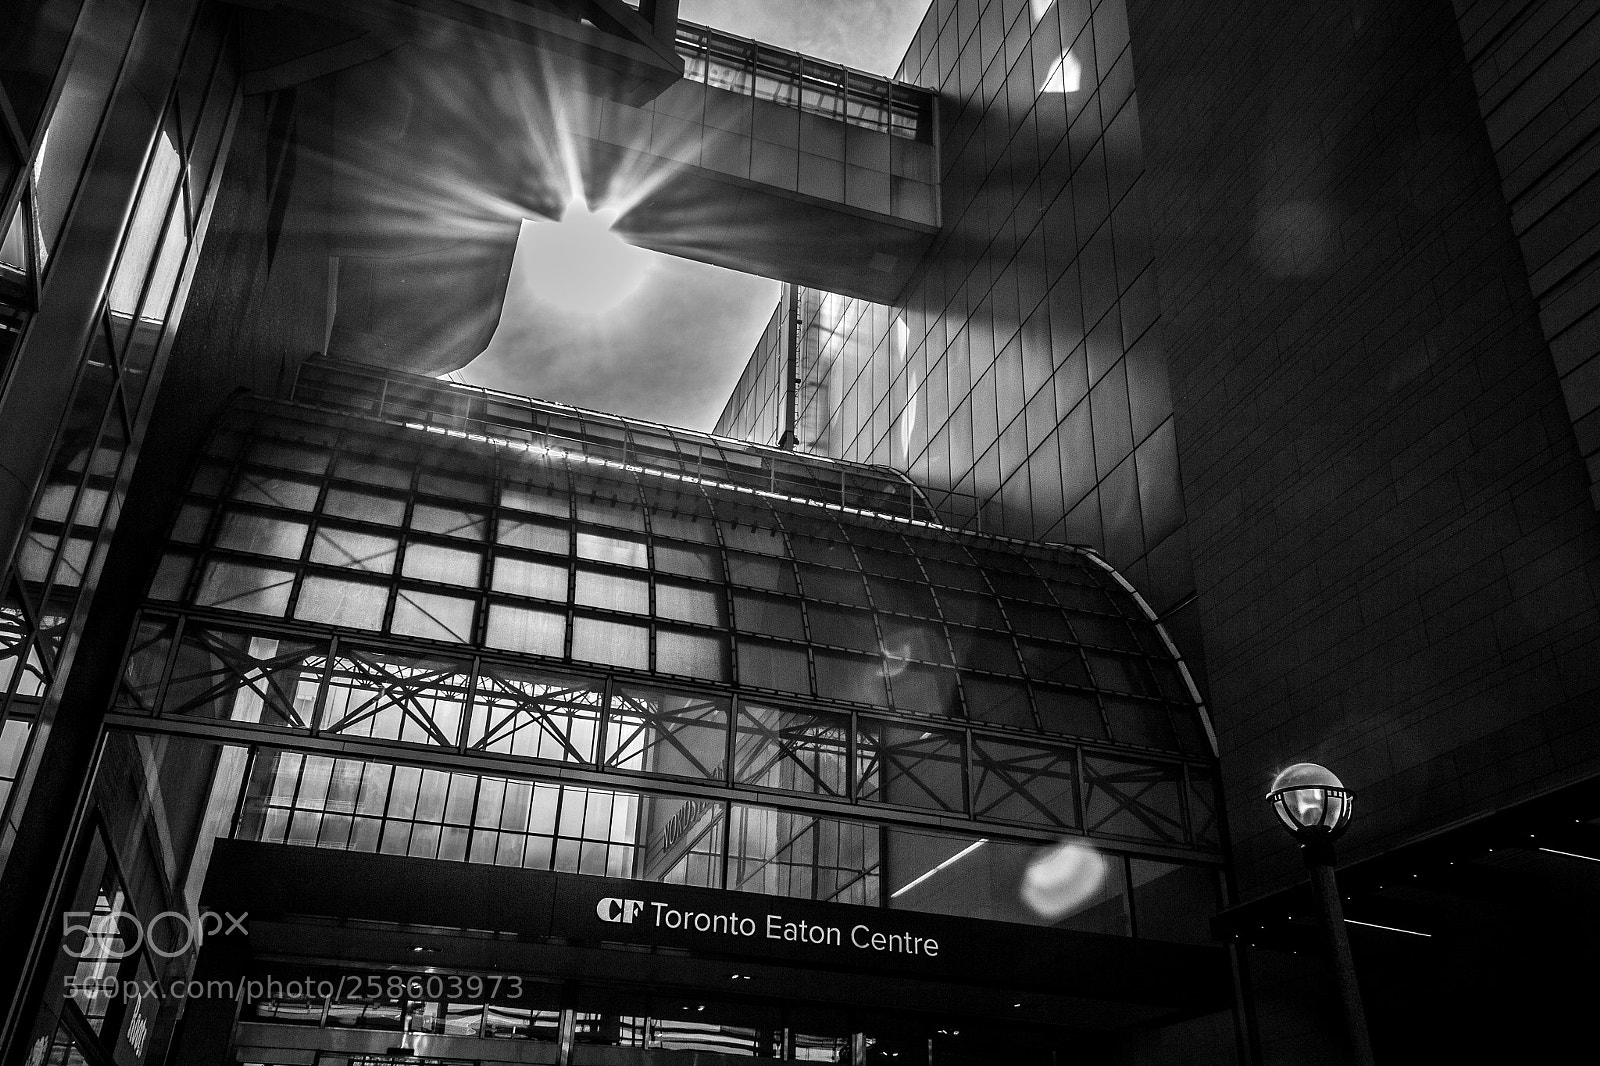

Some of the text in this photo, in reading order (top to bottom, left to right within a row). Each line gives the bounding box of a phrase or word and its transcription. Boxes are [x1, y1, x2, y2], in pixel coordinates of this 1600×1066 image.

[596, 897, 939, 957] CF Toronto Eaton Centre
